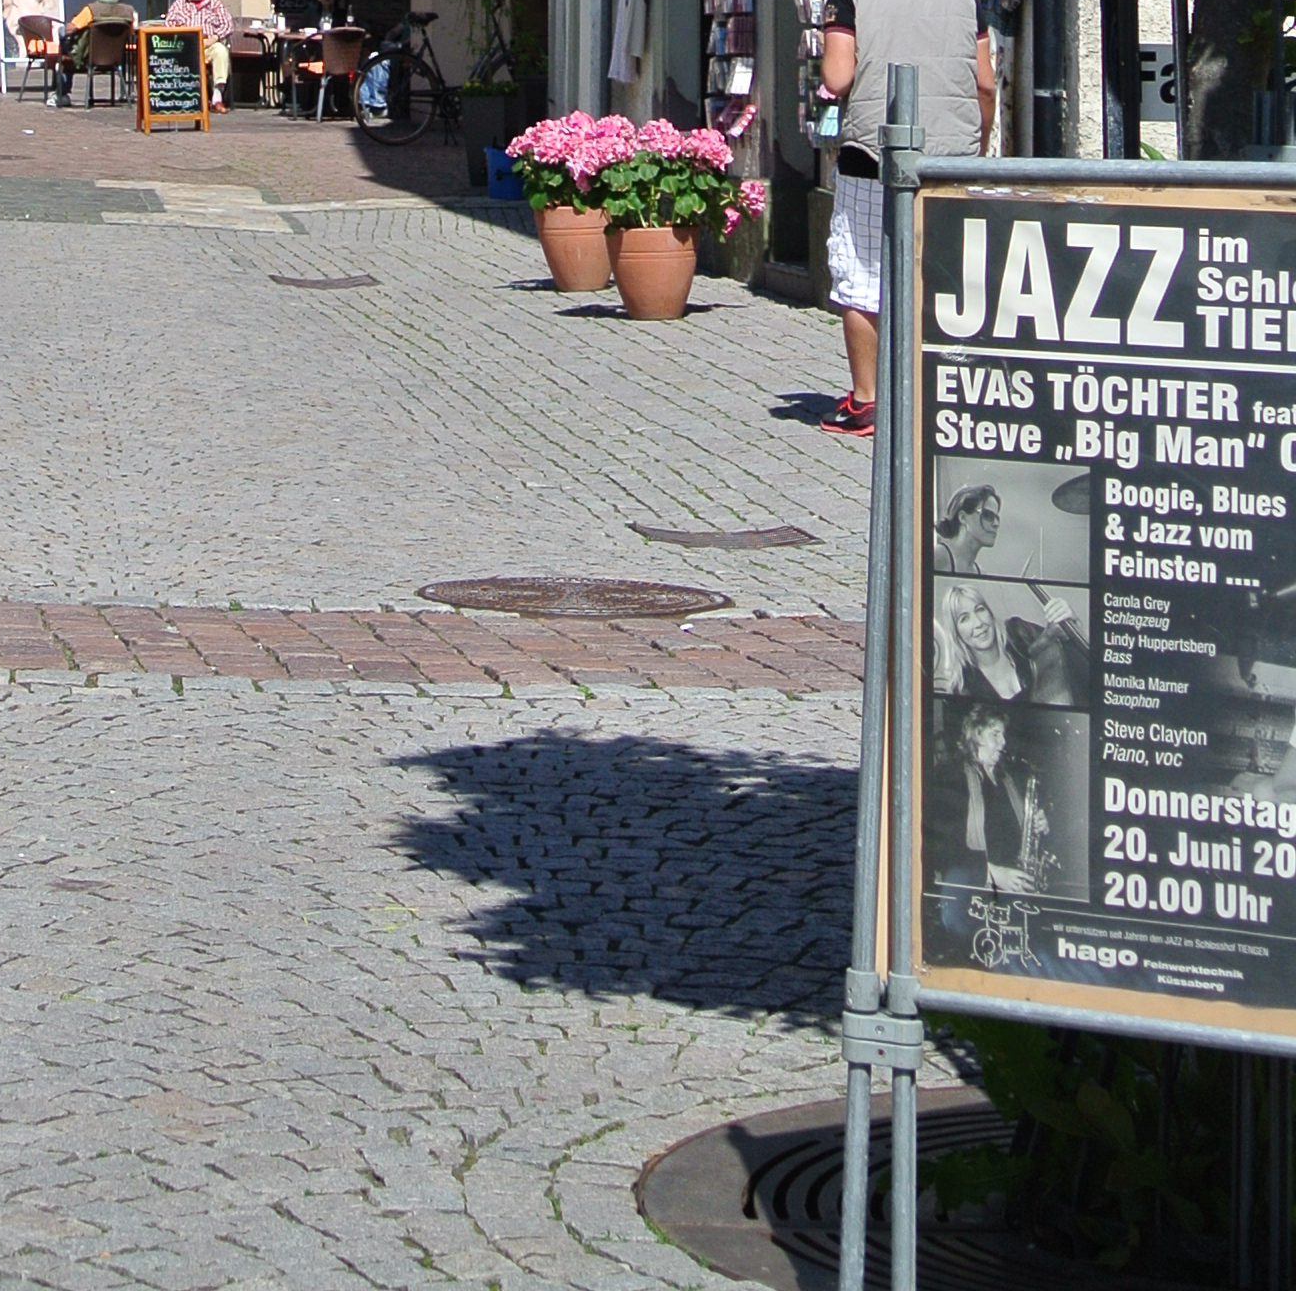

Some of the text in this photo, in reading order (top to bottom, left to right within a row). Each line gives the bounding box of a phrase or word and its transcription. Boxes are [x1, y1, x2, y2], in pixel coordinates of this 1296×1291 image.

[1198, 228, 1249, 264] im
[935, 218, 1185, 349] JAZZ
[1197, 267, 1296, 304] Schl
[936, 365, 1034, 409] EVAS
[1047, 366, 1240, 422] TÖCHTER
[935, 409, 1042, 454] Steve
[1105, 478, 1286, 518] Boogie, Blues
[1105, 513, 1253, 550] & Jazz vom
[1105, 548, 1217, 584] Feinsten
[1104, 592, 1170, 613] Carola Grey
[1103, 610, 1170, 631] Schlagzeug
[1103, 649, 1133, 665] Bass
[1104, 631, 1217, 657] Lindy Huppertsberg
[1104, 673, 1190, 694] Monika Marner
[1103, 691, 1160, 709] Saxophon
[1104, 719, 1208, 747] Steve Clayton
[1103, 742, 1184, 767] Piano, voc
[1105, 776, 1296, 839] Donnerstag
[1104, 824, 1158, 864] 20.
[1168, 831, 1242, 873] Juni
[1104, 871, 1273, 924] 20.00 Uhr
[1057, 937, 1139, 968] hago
[1109, 929, 1123, 940] seit
[1124, 931, 1148, 942] Jahren
[1150, 934, 1163, 944] den
[1195, 938, 1236, 952] Schlosshof
[1143, 958, 1244, 980] Feinwerktechnik
[1157, 974, 1225, 992] Küssaberg
